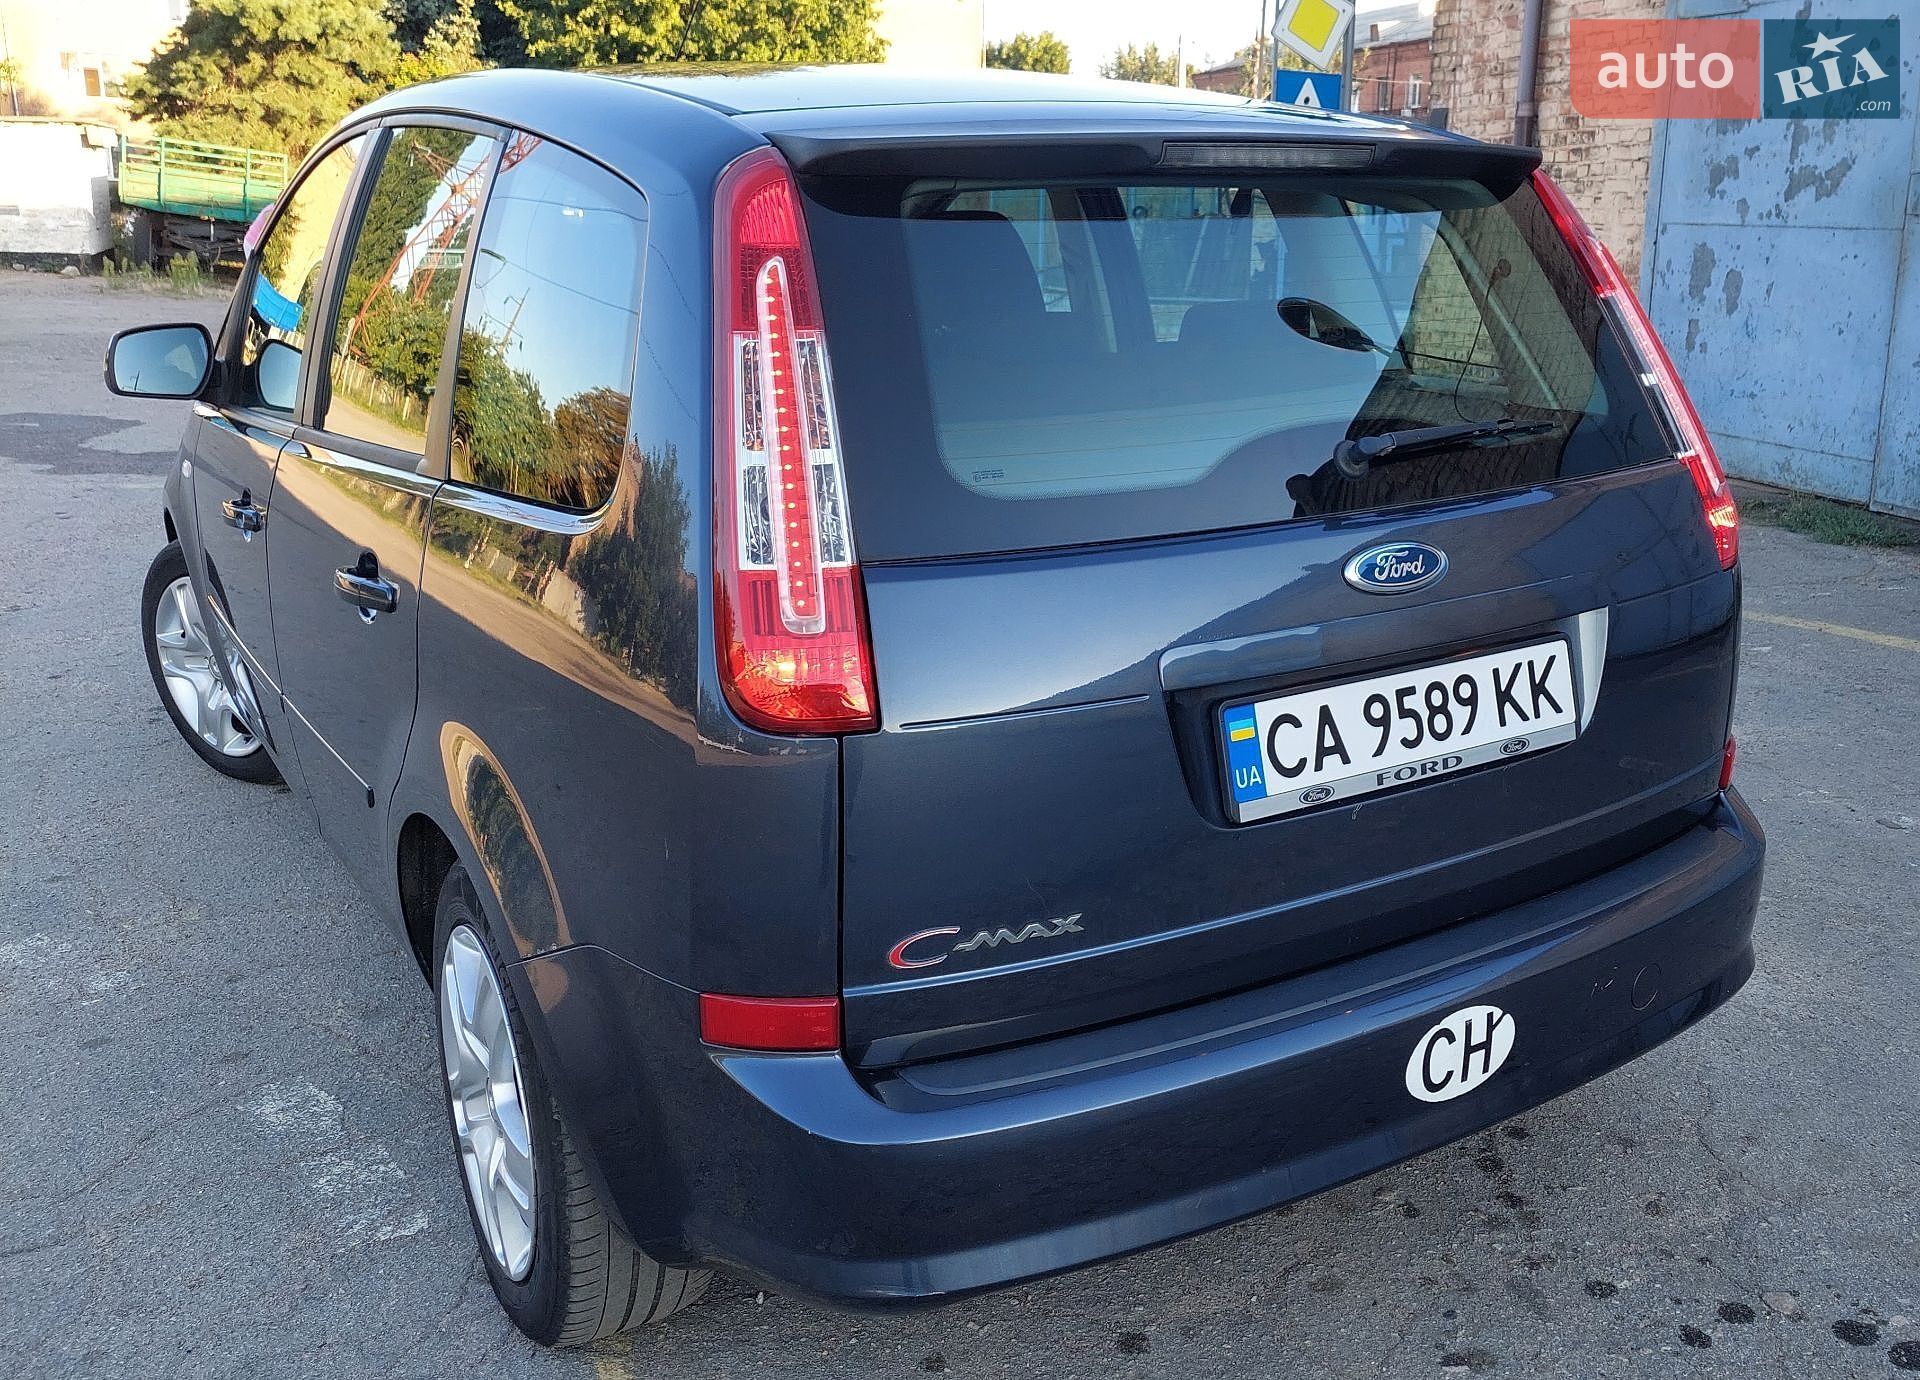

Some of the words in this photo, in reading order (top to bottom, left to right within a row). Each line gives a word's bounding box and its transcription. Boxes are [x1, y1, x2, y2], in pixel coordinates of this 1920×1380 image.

[1375, 551, 1425, 580] Ford
[1266, 703, 1352, 779] CA
[1363, 673, 1479, 758] 9589
[1492, 654, 1564, 728] KK
[1235, 767, 1262, 789] UA
[1376, 755, 1463, 787] FORD
[1422, 1011, 1494, 1094] CH
